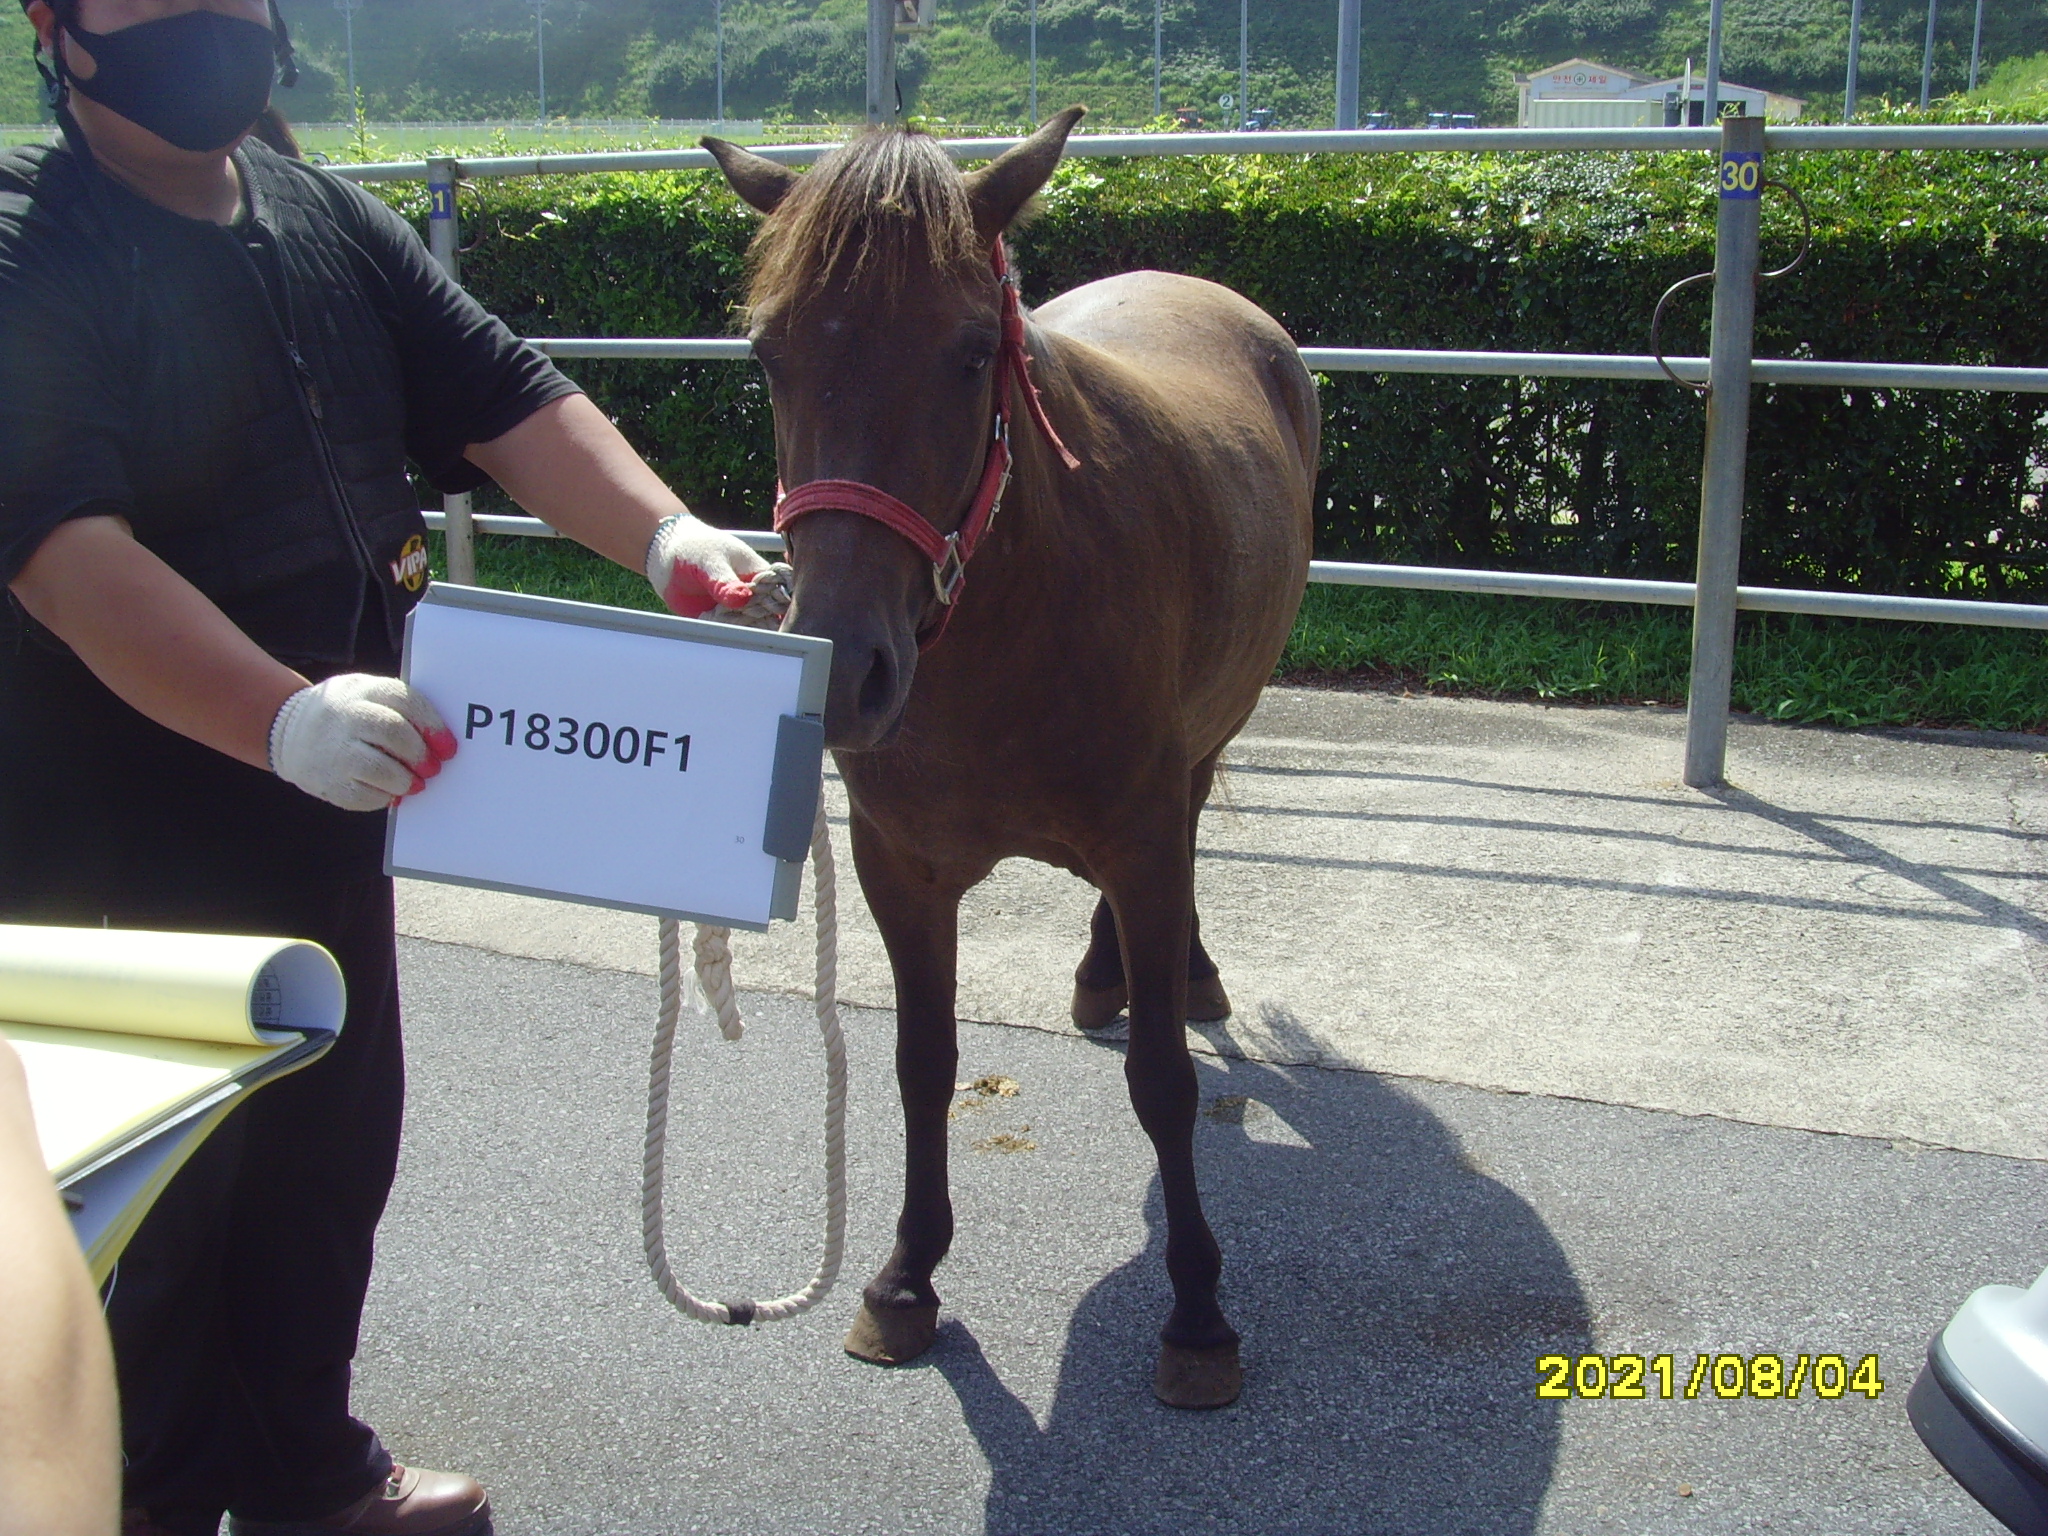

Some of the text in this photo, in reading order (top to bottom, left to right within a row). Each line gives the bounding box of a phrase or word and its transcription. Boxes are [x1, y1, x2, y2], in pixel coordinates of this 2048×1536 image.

[1222, 95, 1231, 108] 2
[1722, 160, 1758, 191] 30
[465, 702, 692, 772] P18300F1
